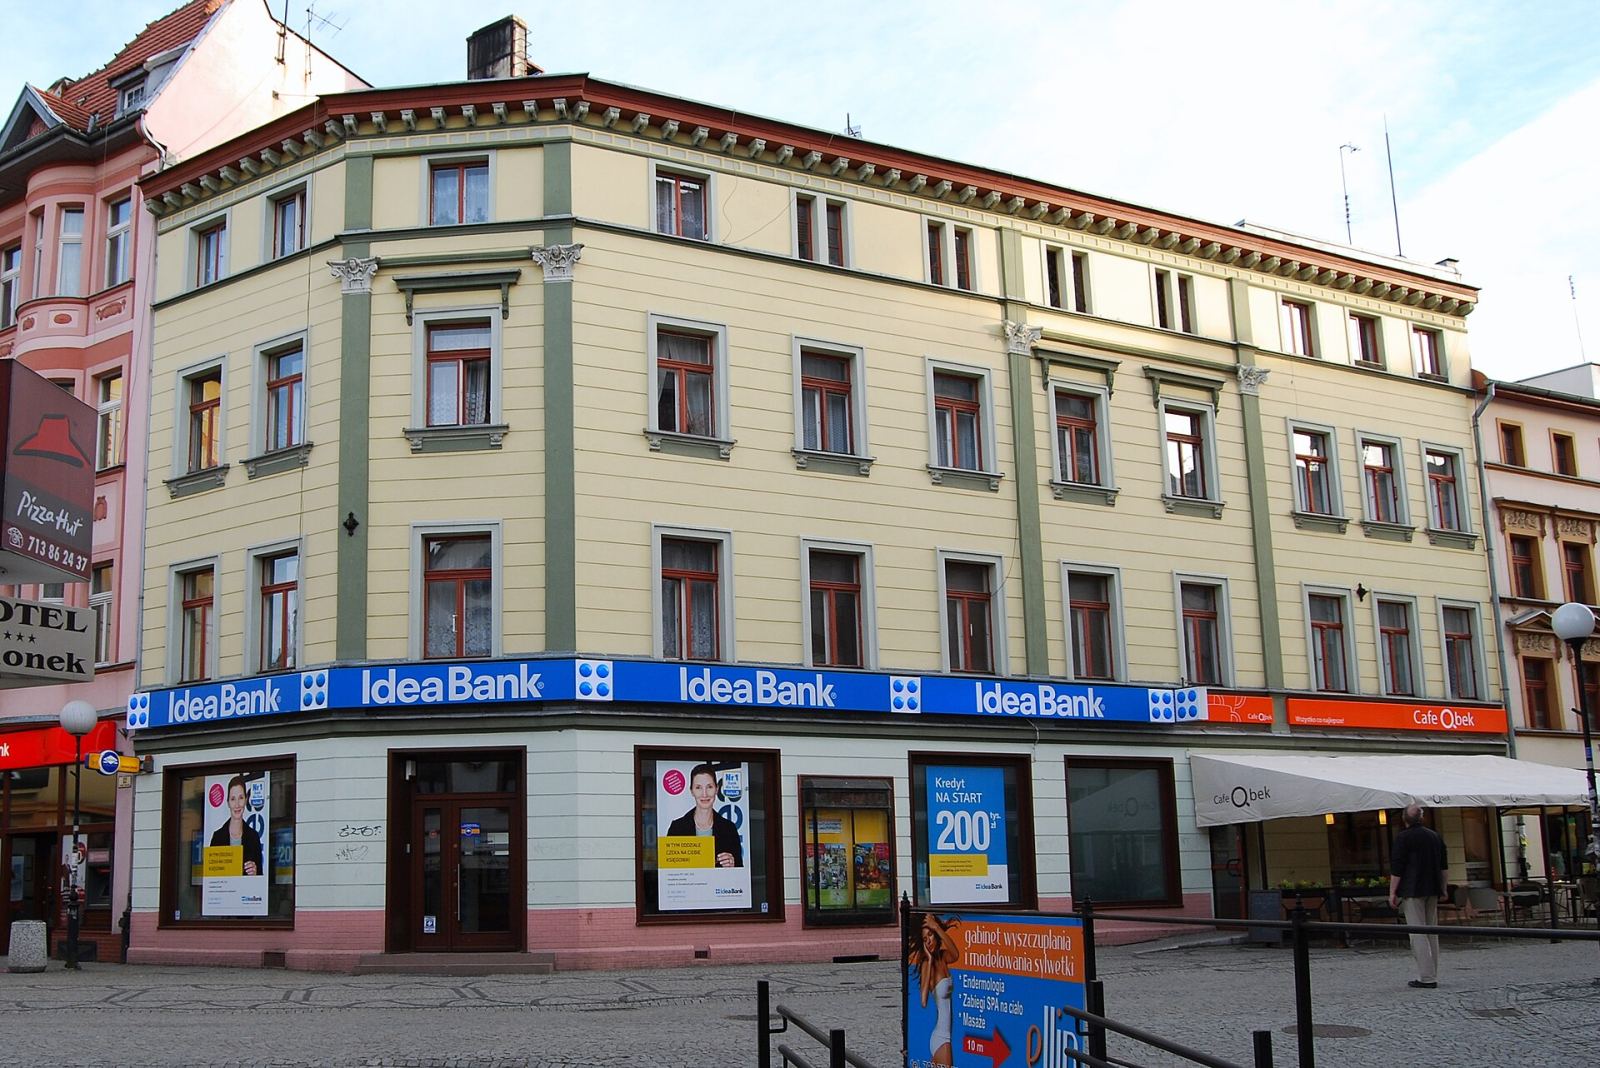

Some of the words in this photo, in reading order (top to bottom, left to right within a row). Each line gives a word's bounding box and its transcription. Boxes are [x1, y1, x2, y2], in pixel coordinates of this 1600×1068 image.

[17, 491, 54, 524] Pizza
[56, 509, 83, 536] Hut
[28, 536, 46, 556] 713
[48, 544, 60, 561] 86
[63, 549, 74, 567] 24
[76, 555, 87, 571] 37
[1413, 710, 1438, 724] Cafe
[1440, 708, 1474, 728] Qbek
[935, 777, 966, 791] Kredyt
[935, 792, 950, 803] NA
[952, 792, 982, 803] START
[1214, 793, 1230, 805] Cafe
[936, 810, 991, 851] 200
[964, 925, 1001, 948] gabinet
[1003, 929, 1071, 954] wyszczuplania
[964, 947, 968, 965] i
[969, 949, 1032, 972] modelowania
[1034, 954, 1074, 978] sylwetki
[963, 974, 1004, 995] Endermologia
[962, 993, 985, 1012] Zabiegi
[986, 996, 999, 1011] SPA
[1000, 1001, 1008, 1013] na
[967, 1039, 976, 1051] 10
[976, 1043, 984, 1052] m
